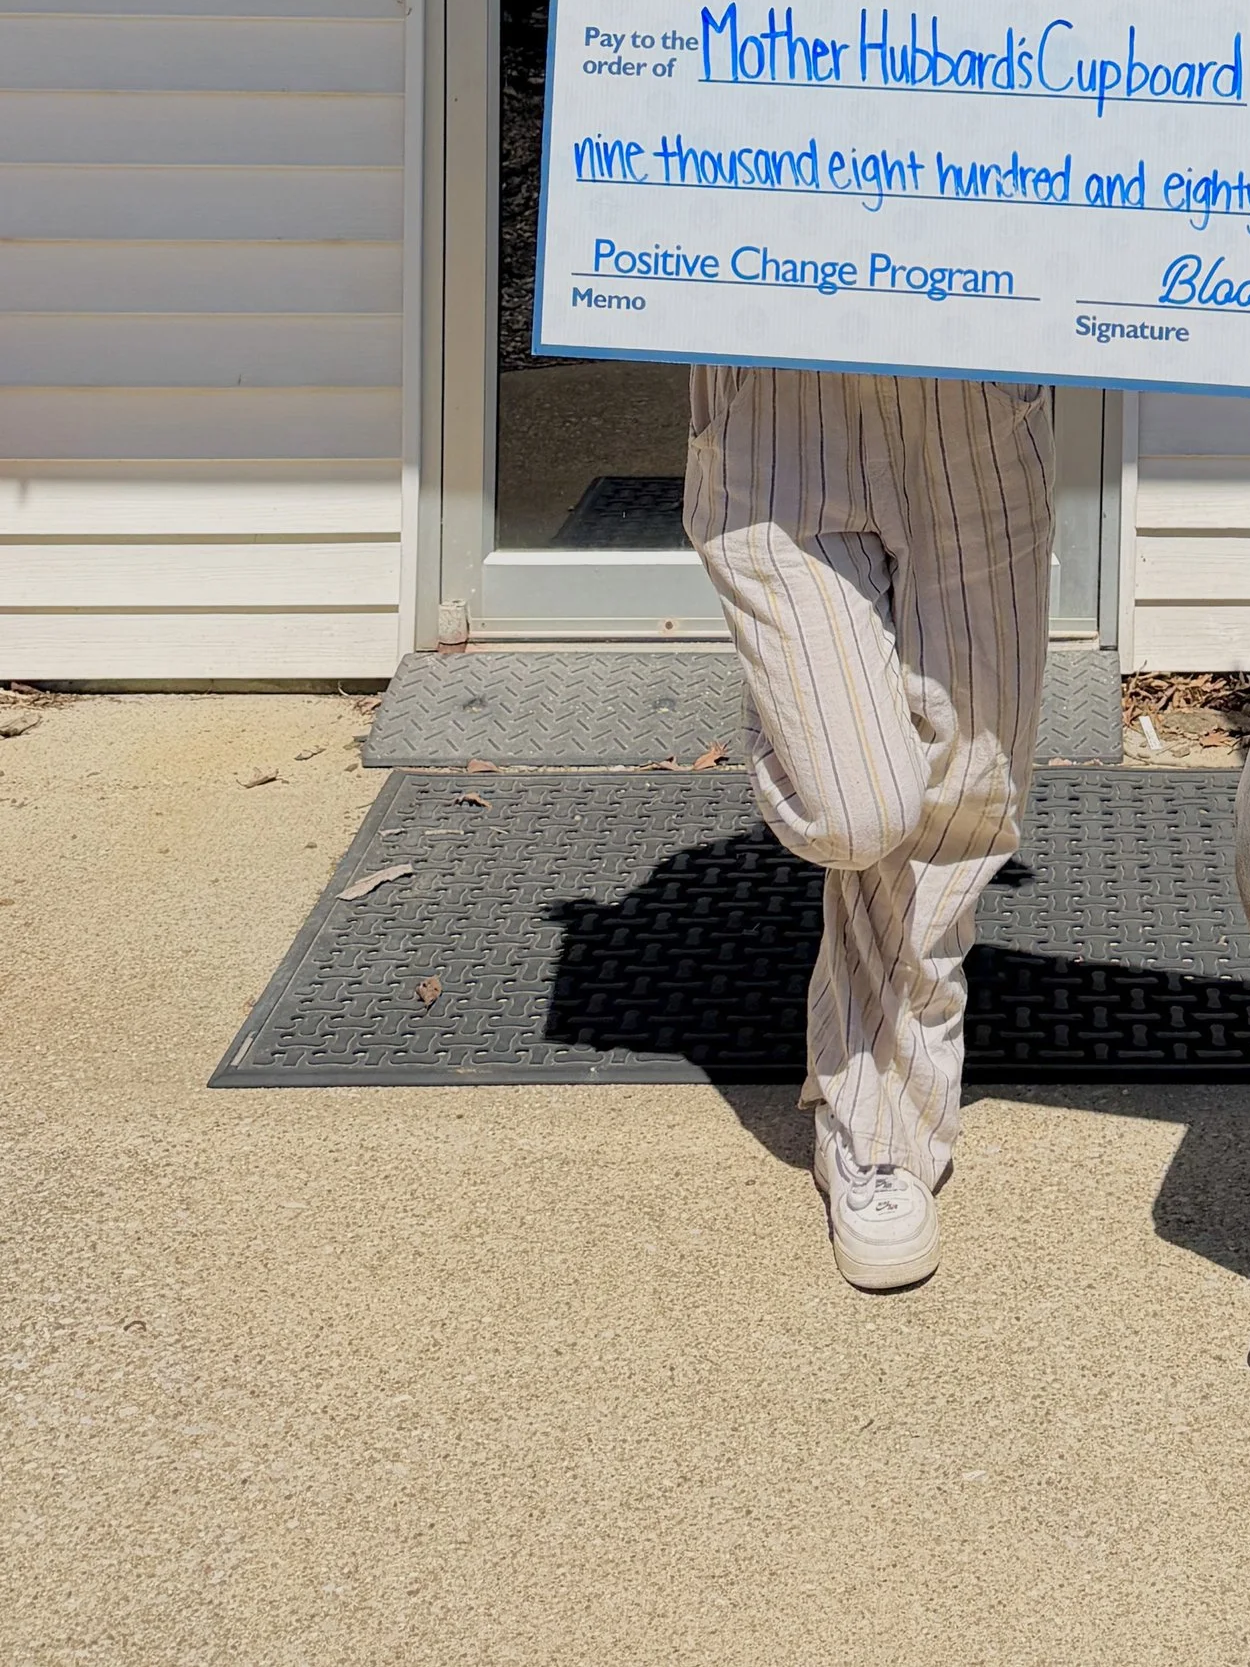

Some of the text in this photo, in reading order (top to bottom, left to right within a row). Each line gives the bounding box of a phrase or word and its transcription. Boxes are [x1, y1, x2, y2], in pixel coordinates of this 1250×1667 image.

[584, 26, 699, 52] Pay to the
[582, 56, 677, 78] order of
[699, 2, 1244, 118] Mother Hubbard's Cupboard
[573, 134, 648, 184] nine
[652, 134, 819, 190] thousand
[829, 146, 925, 212] eight
[936, 153, 1072, 206] hundred
[1085, 159, 1145, 209] and
[593, 238, 1014, 302] Positive Change Program
[571, 287, 647, 312] Memo
[1075, 313, 1190, 344] Signature
